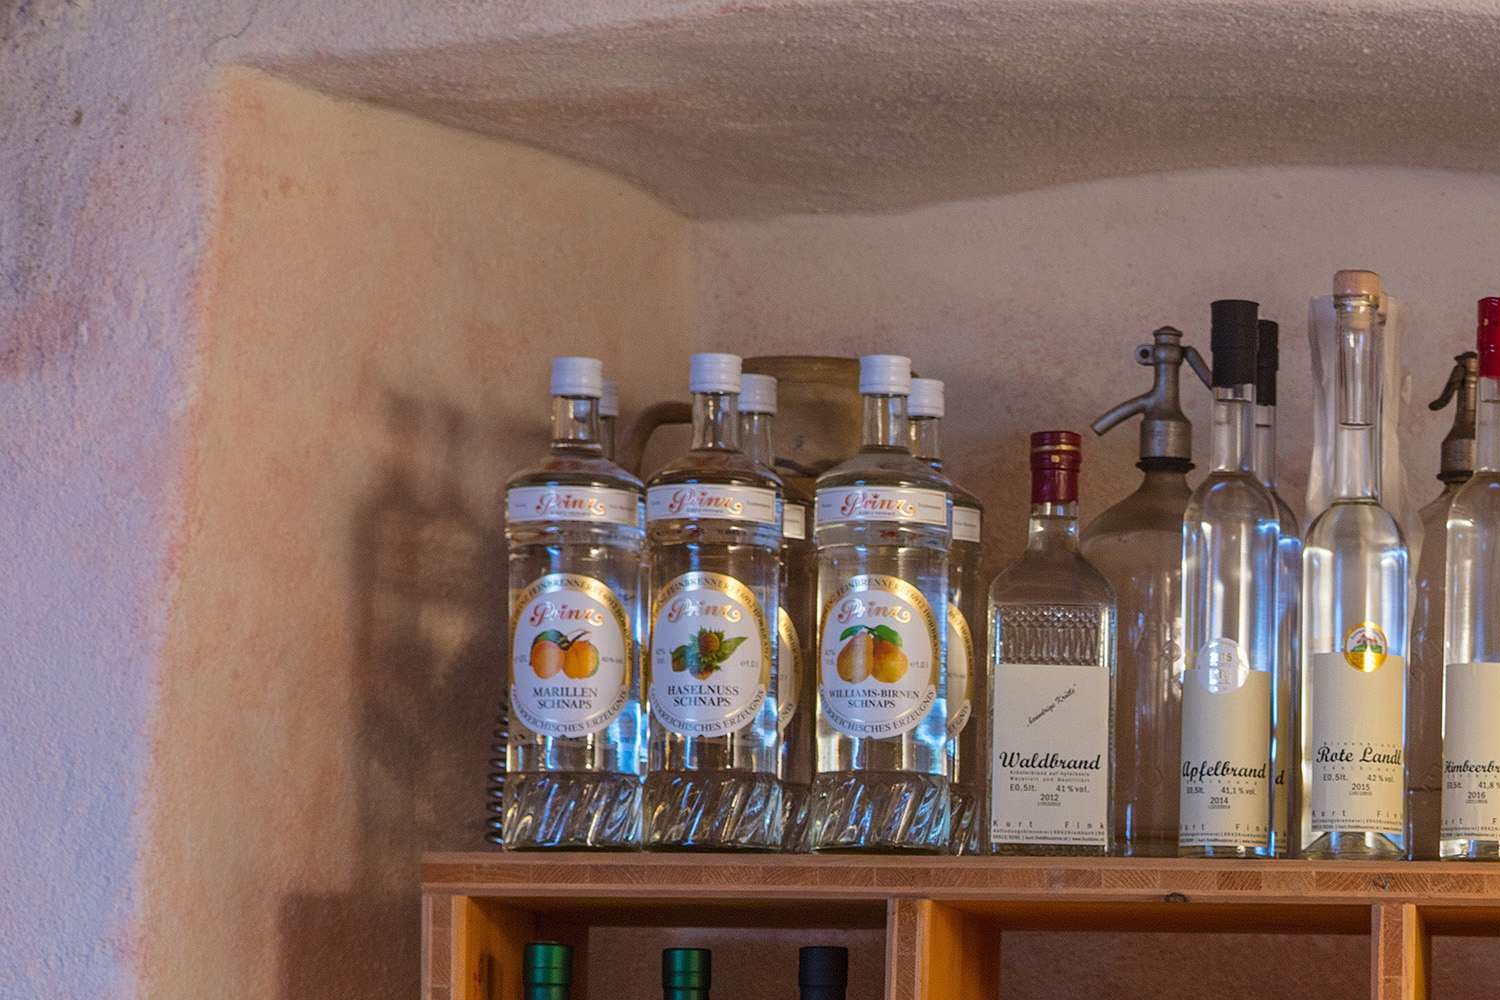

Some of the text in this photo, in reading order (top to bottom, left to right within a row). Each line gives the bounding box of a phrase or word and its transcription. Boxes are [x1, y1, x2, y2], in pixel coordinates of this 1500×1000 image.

[840, 493, 918, 517] Prinz
[532, 687, 599, 698] MARILLEN
[667, 684, 740, 697] HASELNUSS
[536, 699, 593, 711] SCHNAPS
[672, 696, 732, 707] SCHNAPS
[847, 699, 897, 710] SCHNAPS
[999, 750, 1102, 771] Waldbrand
[1315, 746, 1354, 764] Rote
[1182, 760, 1267, 783] Apfelbrand
[1351, 783, 1371, 791] 2015
[1039, 793, 1060, 802] 2012
[1209, 796, 1230, 805] 2014
[1467, 791, 1487, 800] 2016
